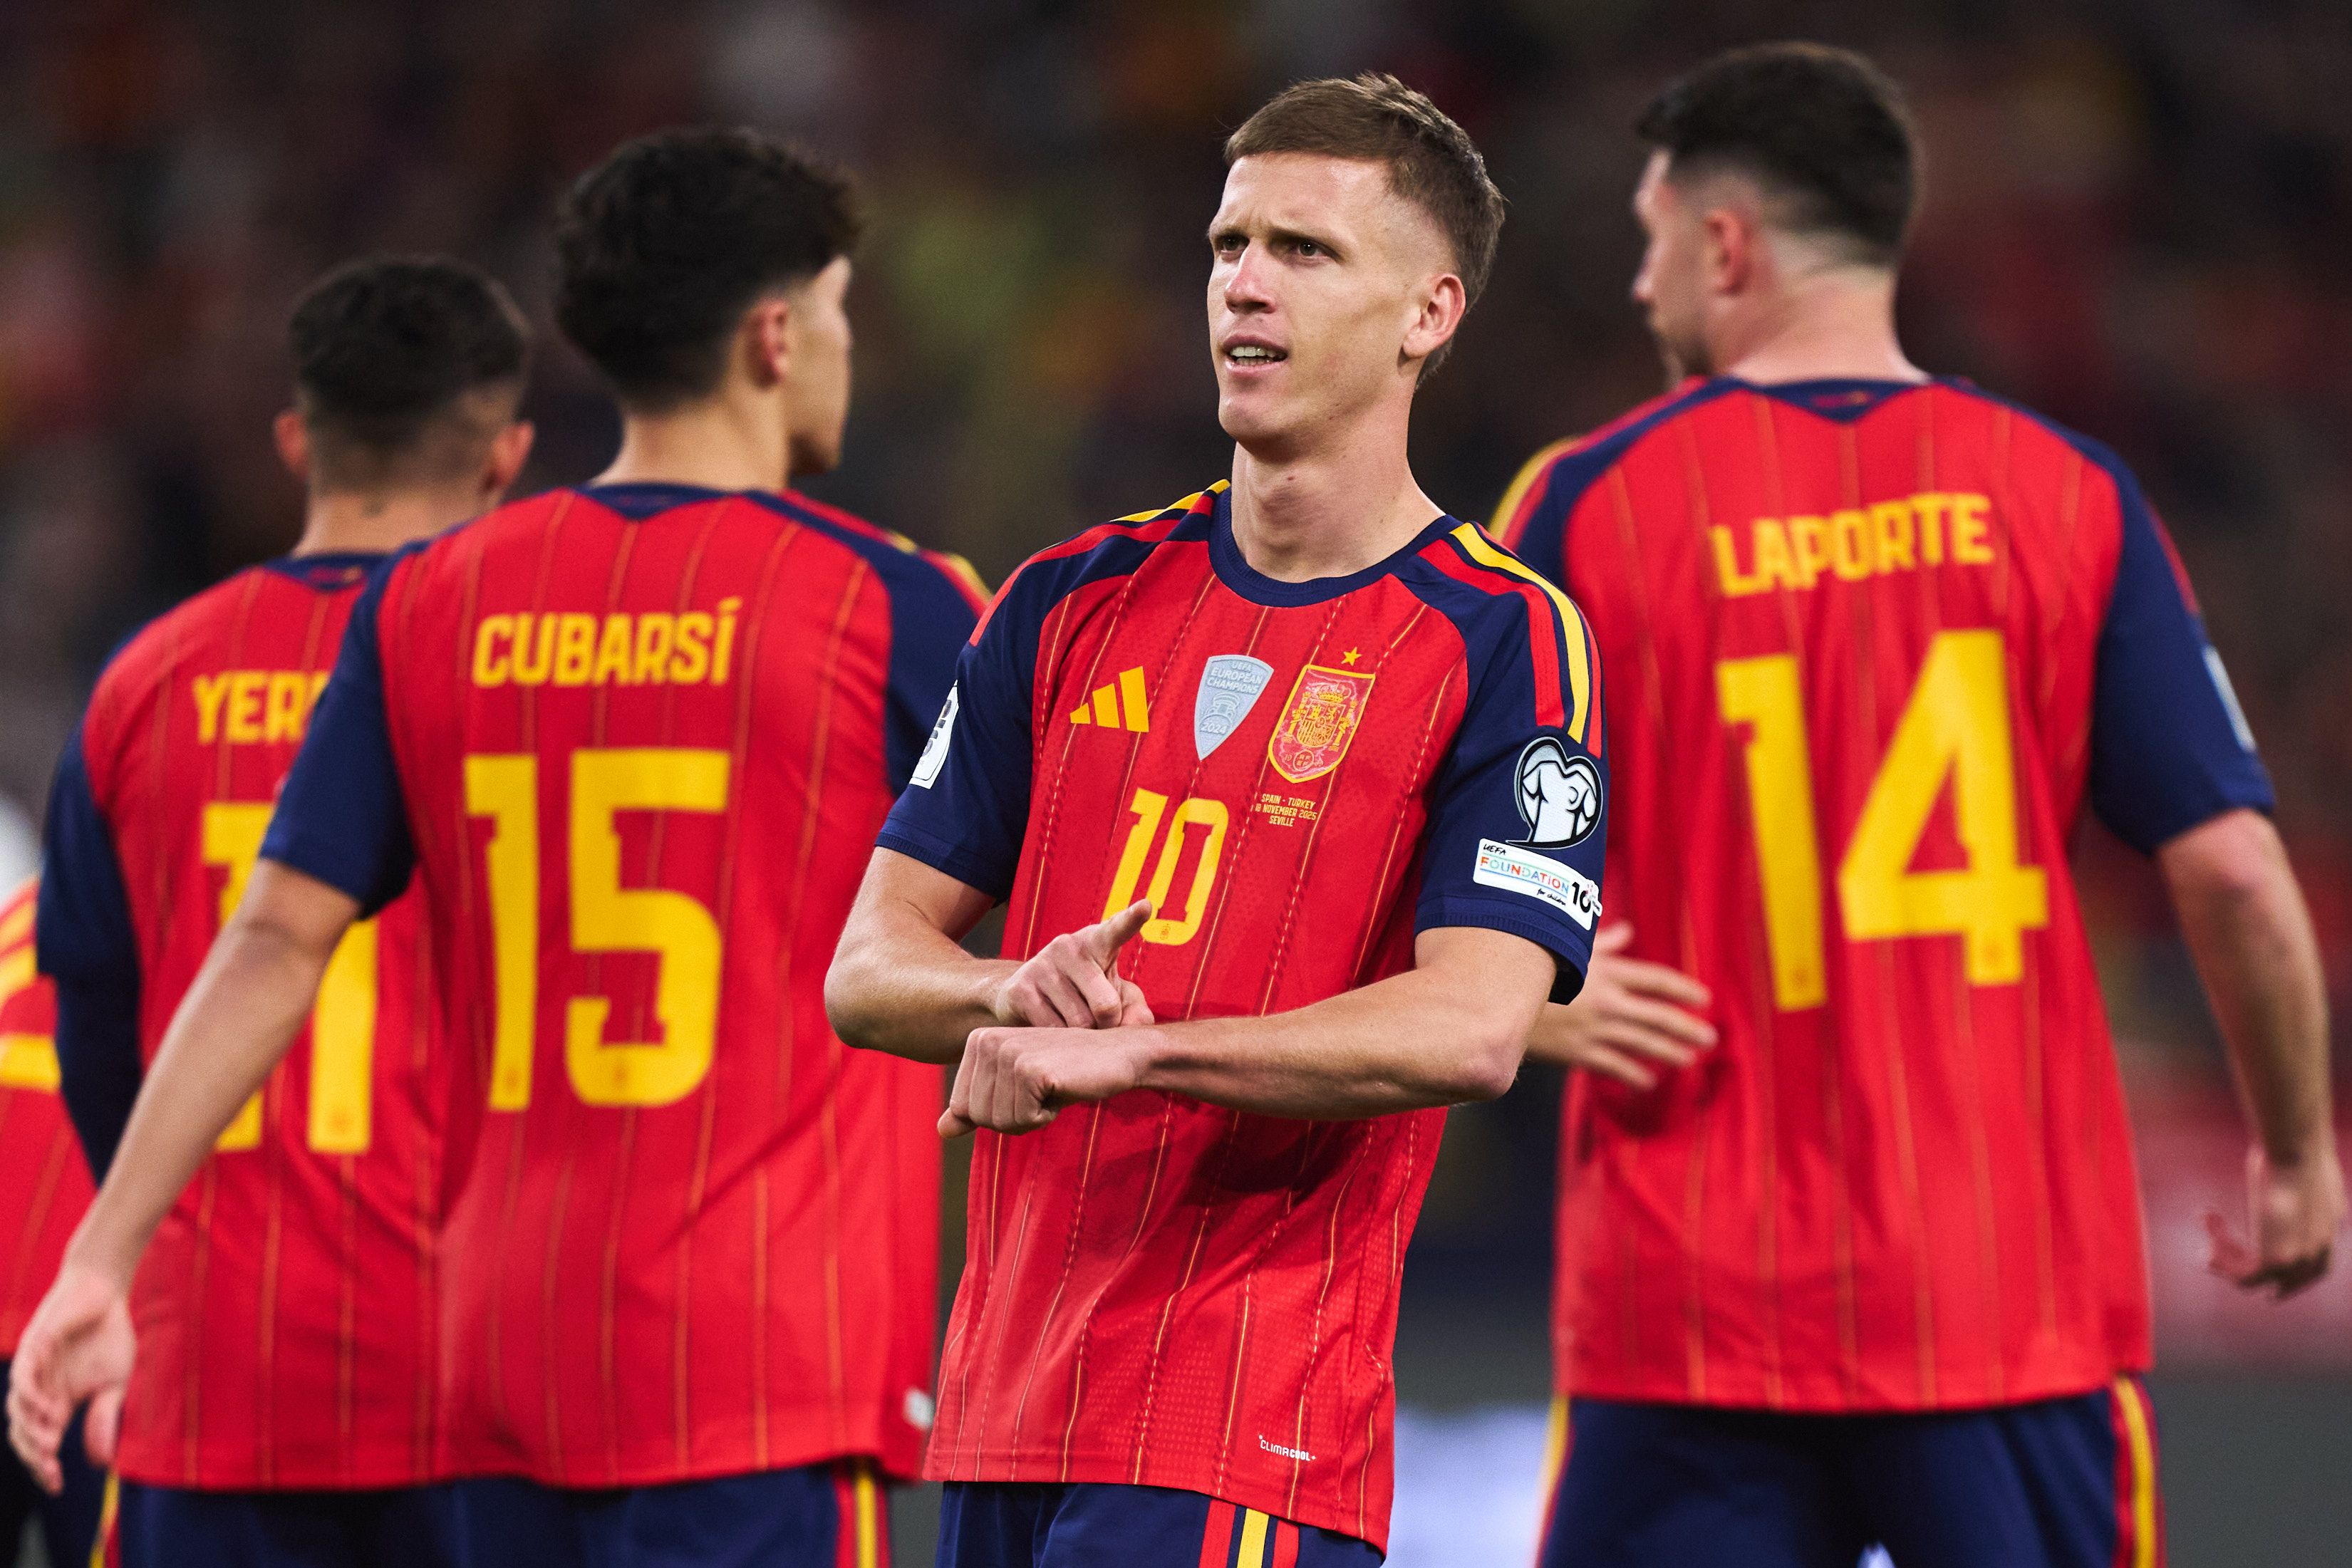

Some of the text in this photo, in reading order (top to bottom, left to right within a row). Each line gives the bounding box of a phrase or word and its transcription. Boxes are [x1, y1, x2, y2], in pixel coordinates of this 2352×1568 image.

[1711, 492, 1994, 598] LAPORTE
[472, 597, 742, 688] CUBARSÍ
[1231, 660, 1253, 673] UEFA
[1211, 667, 1264, 685] EUROPEAN
[1207, 677, 1260, 695] CHAMPIONS
[1201, 721, 1227, 736] 2024
[1261, 793, 1281, 804] SPAIN
[1288, 797, 1315, 810] TURKEY
[1262, 804, 1298, 817] NOVEMBER
[1298, 809, 1317, 821] 2025
[1269, 815, 1295, 826] SEVILLE
[1716, 627, 2050, 1012] 14
[1483, 843, 1507, 856] UEFA
[1100, 787, 1229, 946] 10
[1480, 856, 1570, 895] FOUNDATION
[464, 747, 731, 1112] 15
[1260, 1439, 1310, 1462] CLIMACOOL
